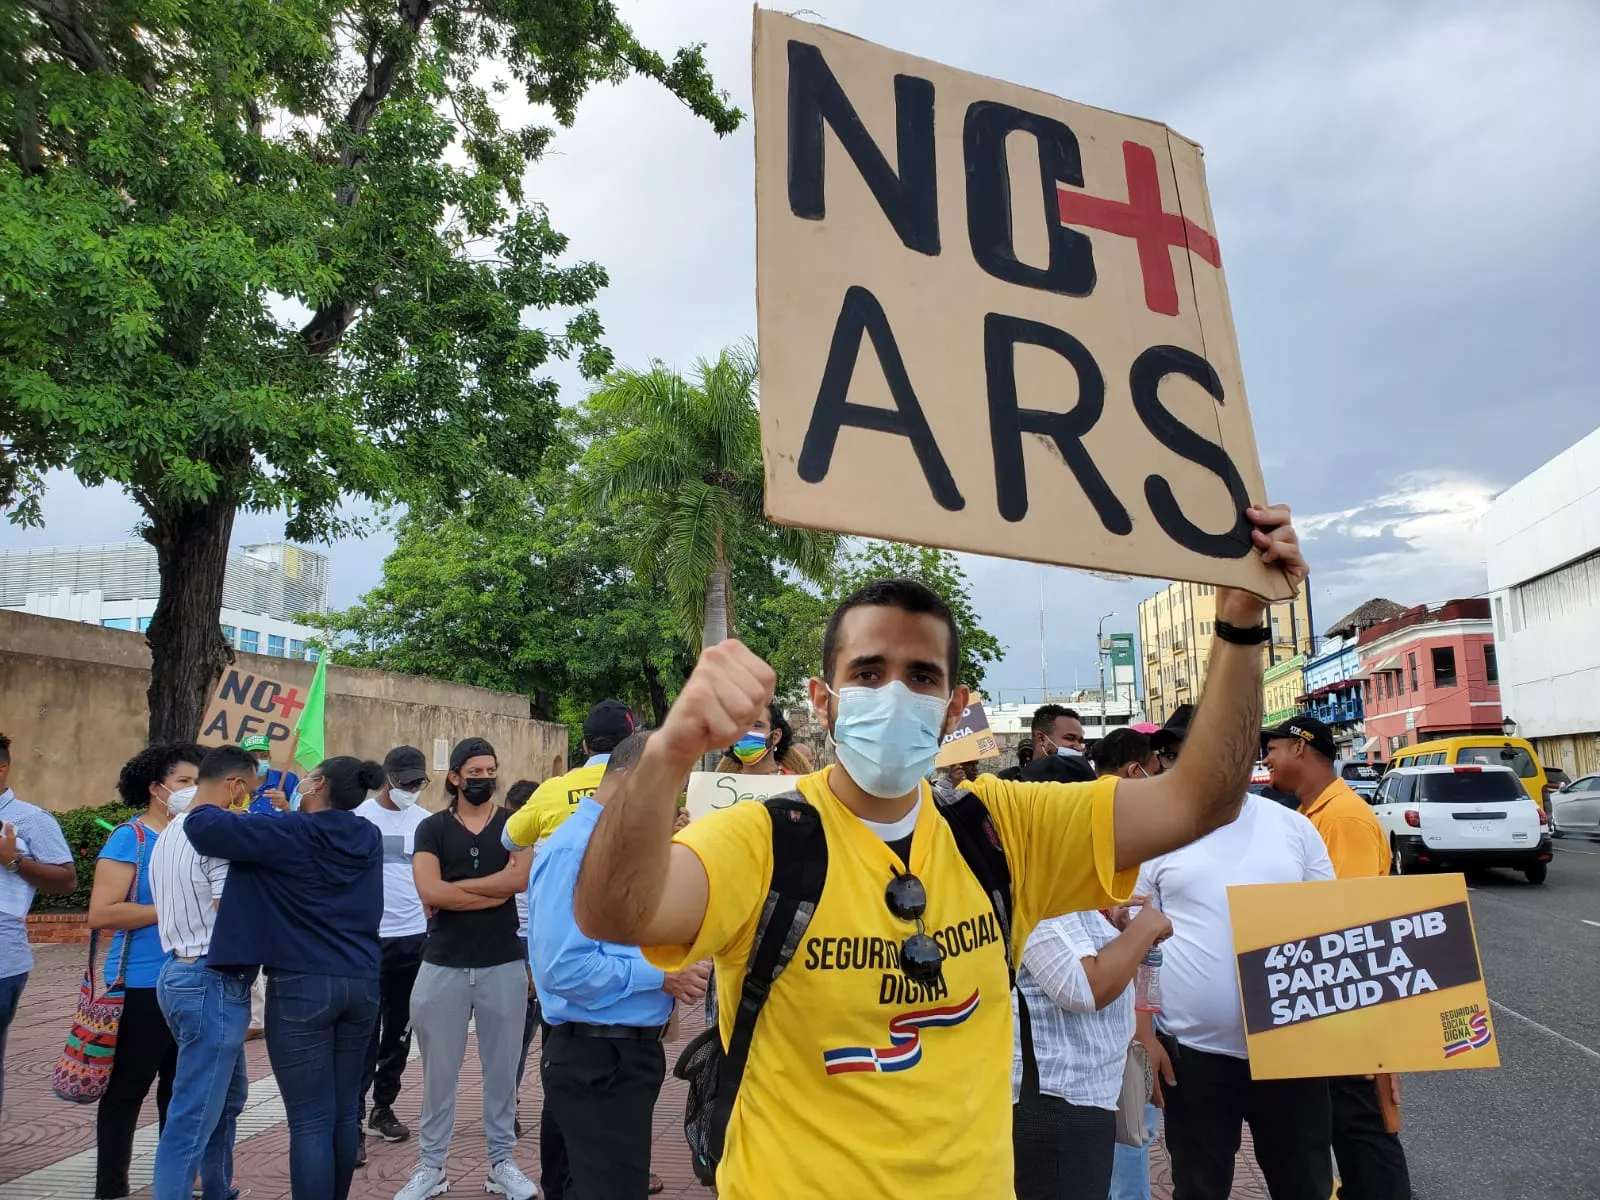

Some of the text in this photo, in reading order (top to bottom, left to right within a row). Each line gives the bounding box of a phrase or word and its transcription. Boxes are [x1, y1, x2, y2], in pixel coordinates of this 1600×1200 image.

[797, 285, 1255, 559] ARS
[203, 710, 290, 742] AFP
[805, 911, 999, 969] SEGURID SOCIAL
[1264, 911, 1447, 969] 4% DEL PIB
[879, 966, 948, 1005] DIGNA
[1267, 946, 1413, 998] PARA LA
[1271, 968, 1438, 1025] SALUD YA
[1440, 1004, 1479, 1021] SEGURIDAD
[1442, 1017, 1468, 1031] SOCIAL
[1444, 1026, 1471, 1042] DIGNA
